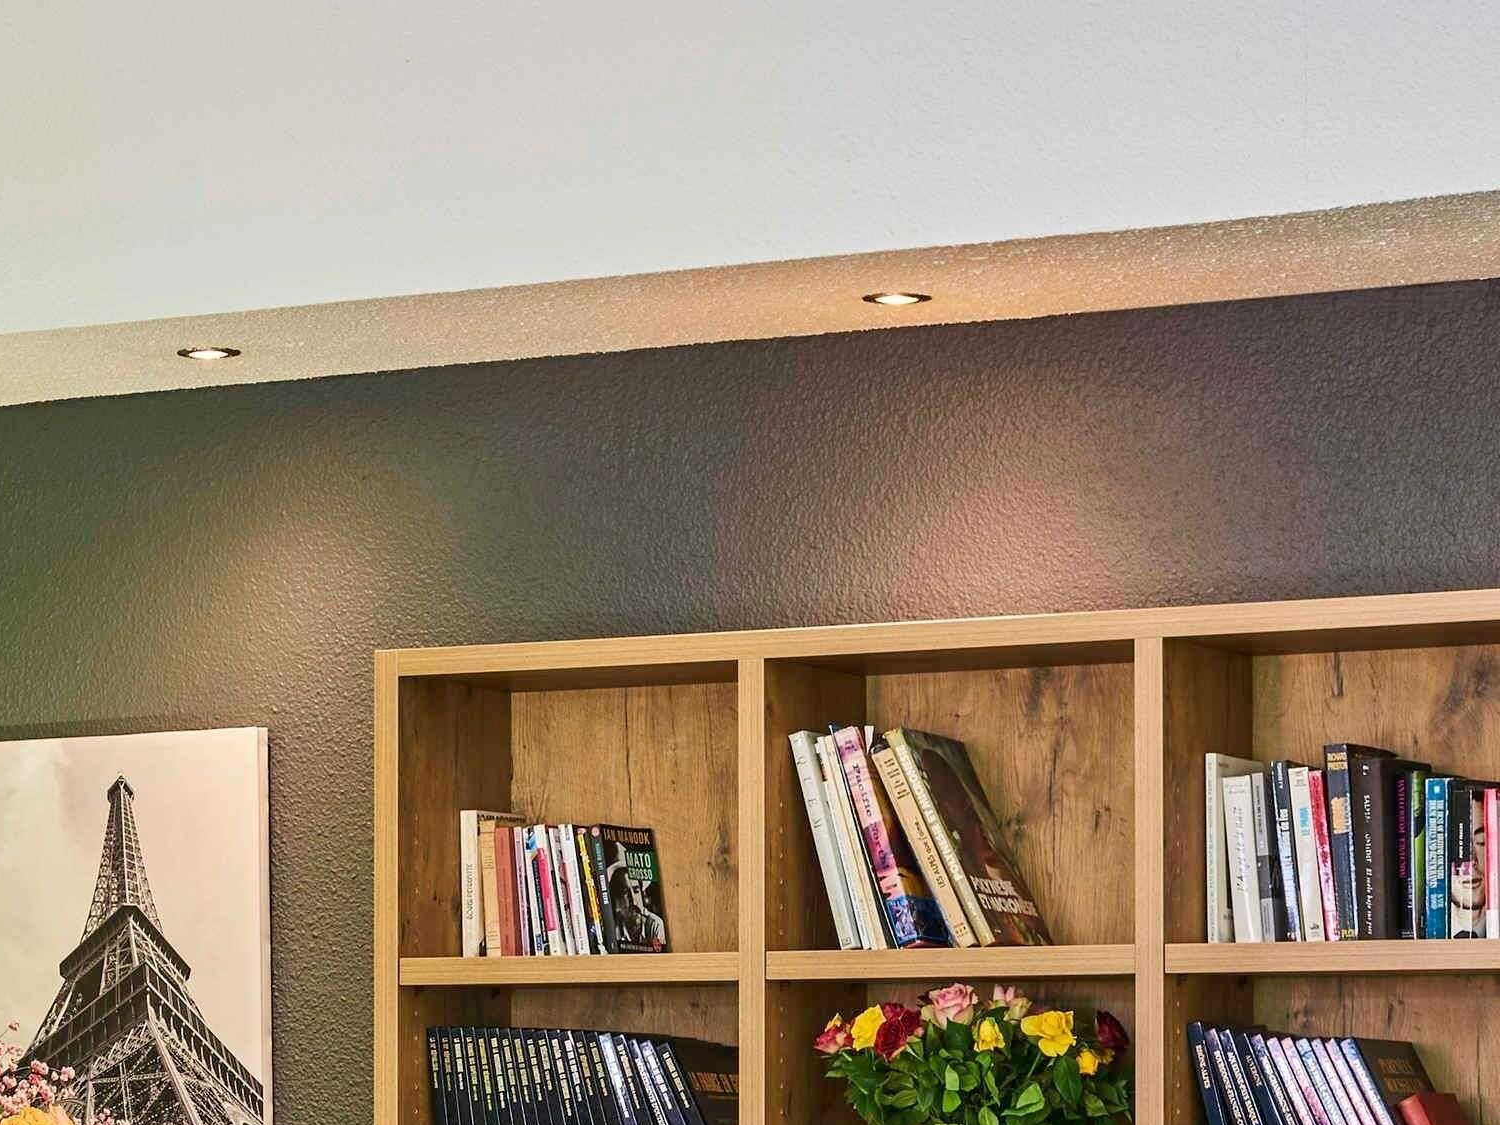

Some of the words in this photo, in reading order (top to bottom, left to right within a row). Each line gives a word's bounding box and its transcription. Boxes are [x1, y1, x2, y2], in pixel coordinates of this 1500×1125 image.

[852, 763, 873, 817] Pacific
[626, 851, 651, 868] MATO
[628, 867, 653, 881] GROSSO
